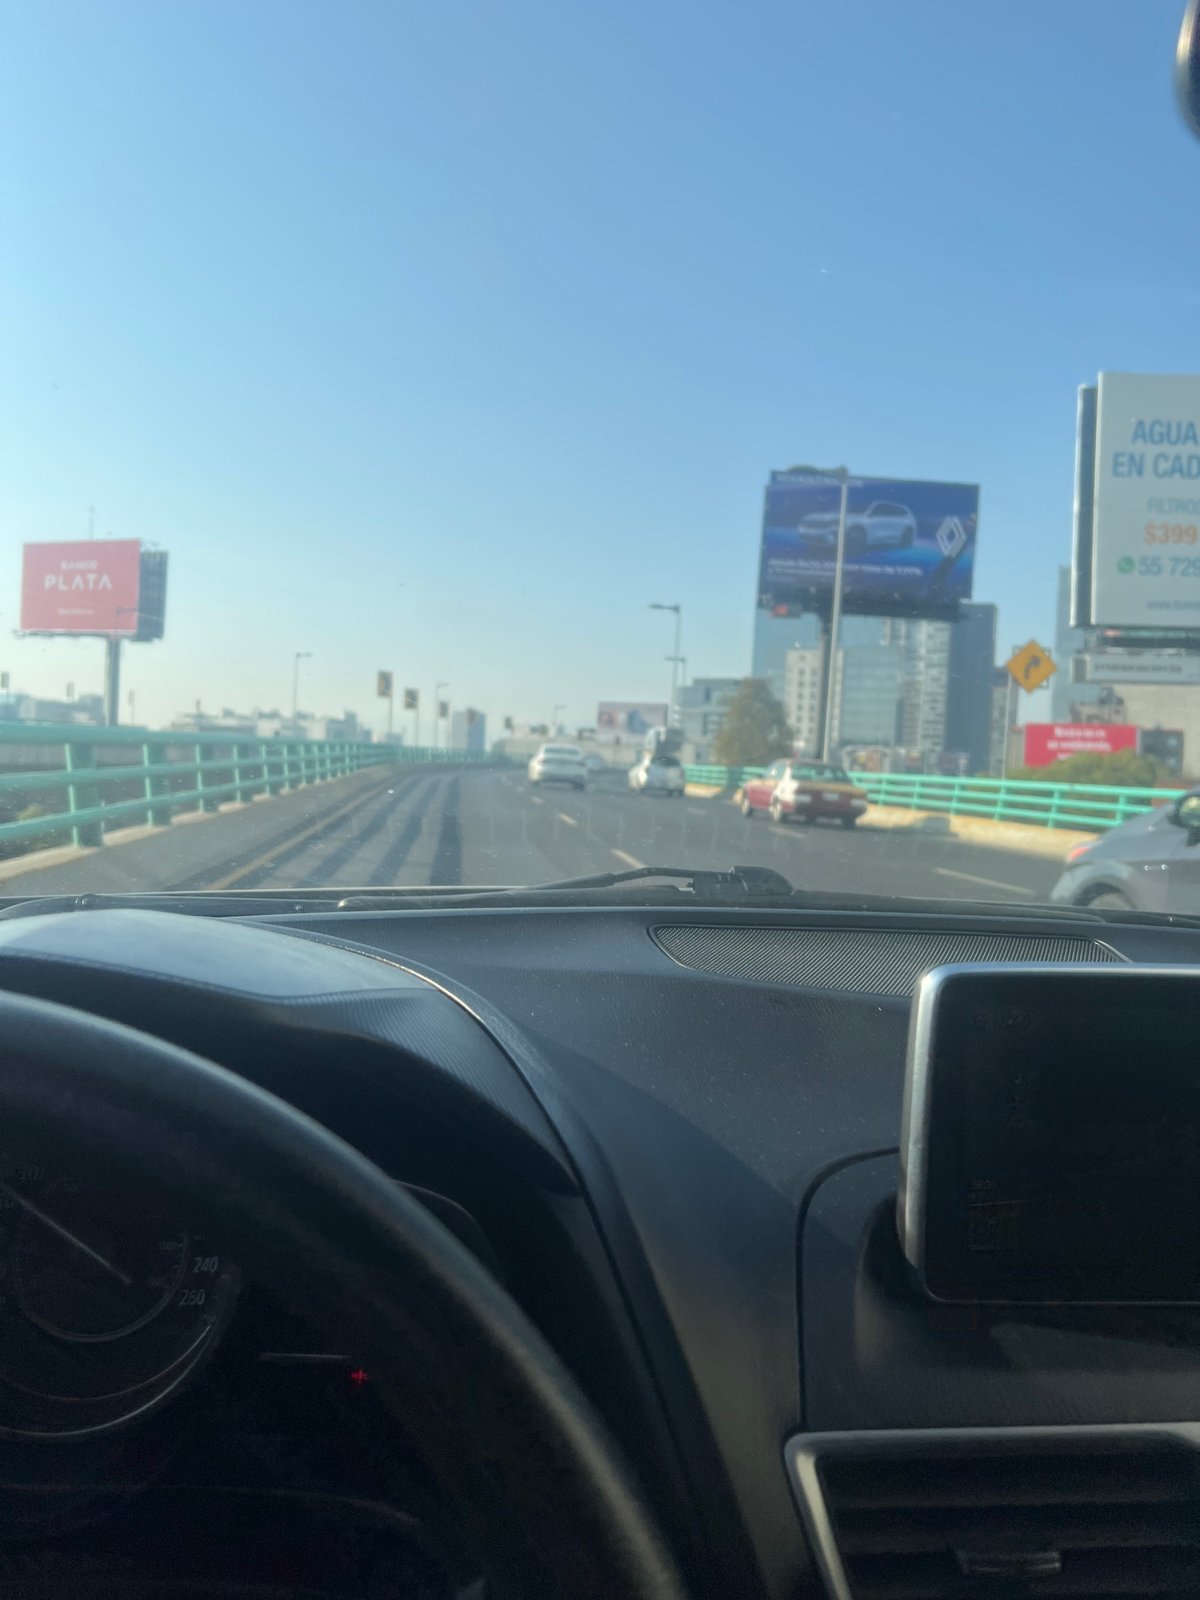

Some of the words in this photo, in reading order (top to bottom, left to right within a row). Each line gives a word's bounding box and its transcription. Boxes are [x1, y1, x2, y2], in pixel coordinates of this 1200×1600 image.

[1131, 418, 1198, 447] AGUA
[1112, 452, 1144, 479] EN
[1144, 522, 1198, 545] $399
[1139, 556, 1163, 576] 55
[44, 573, 112, 592] PLATA
[192, 1255, 219, 1273] 240
[178, 1288, 206, 1306] 260
